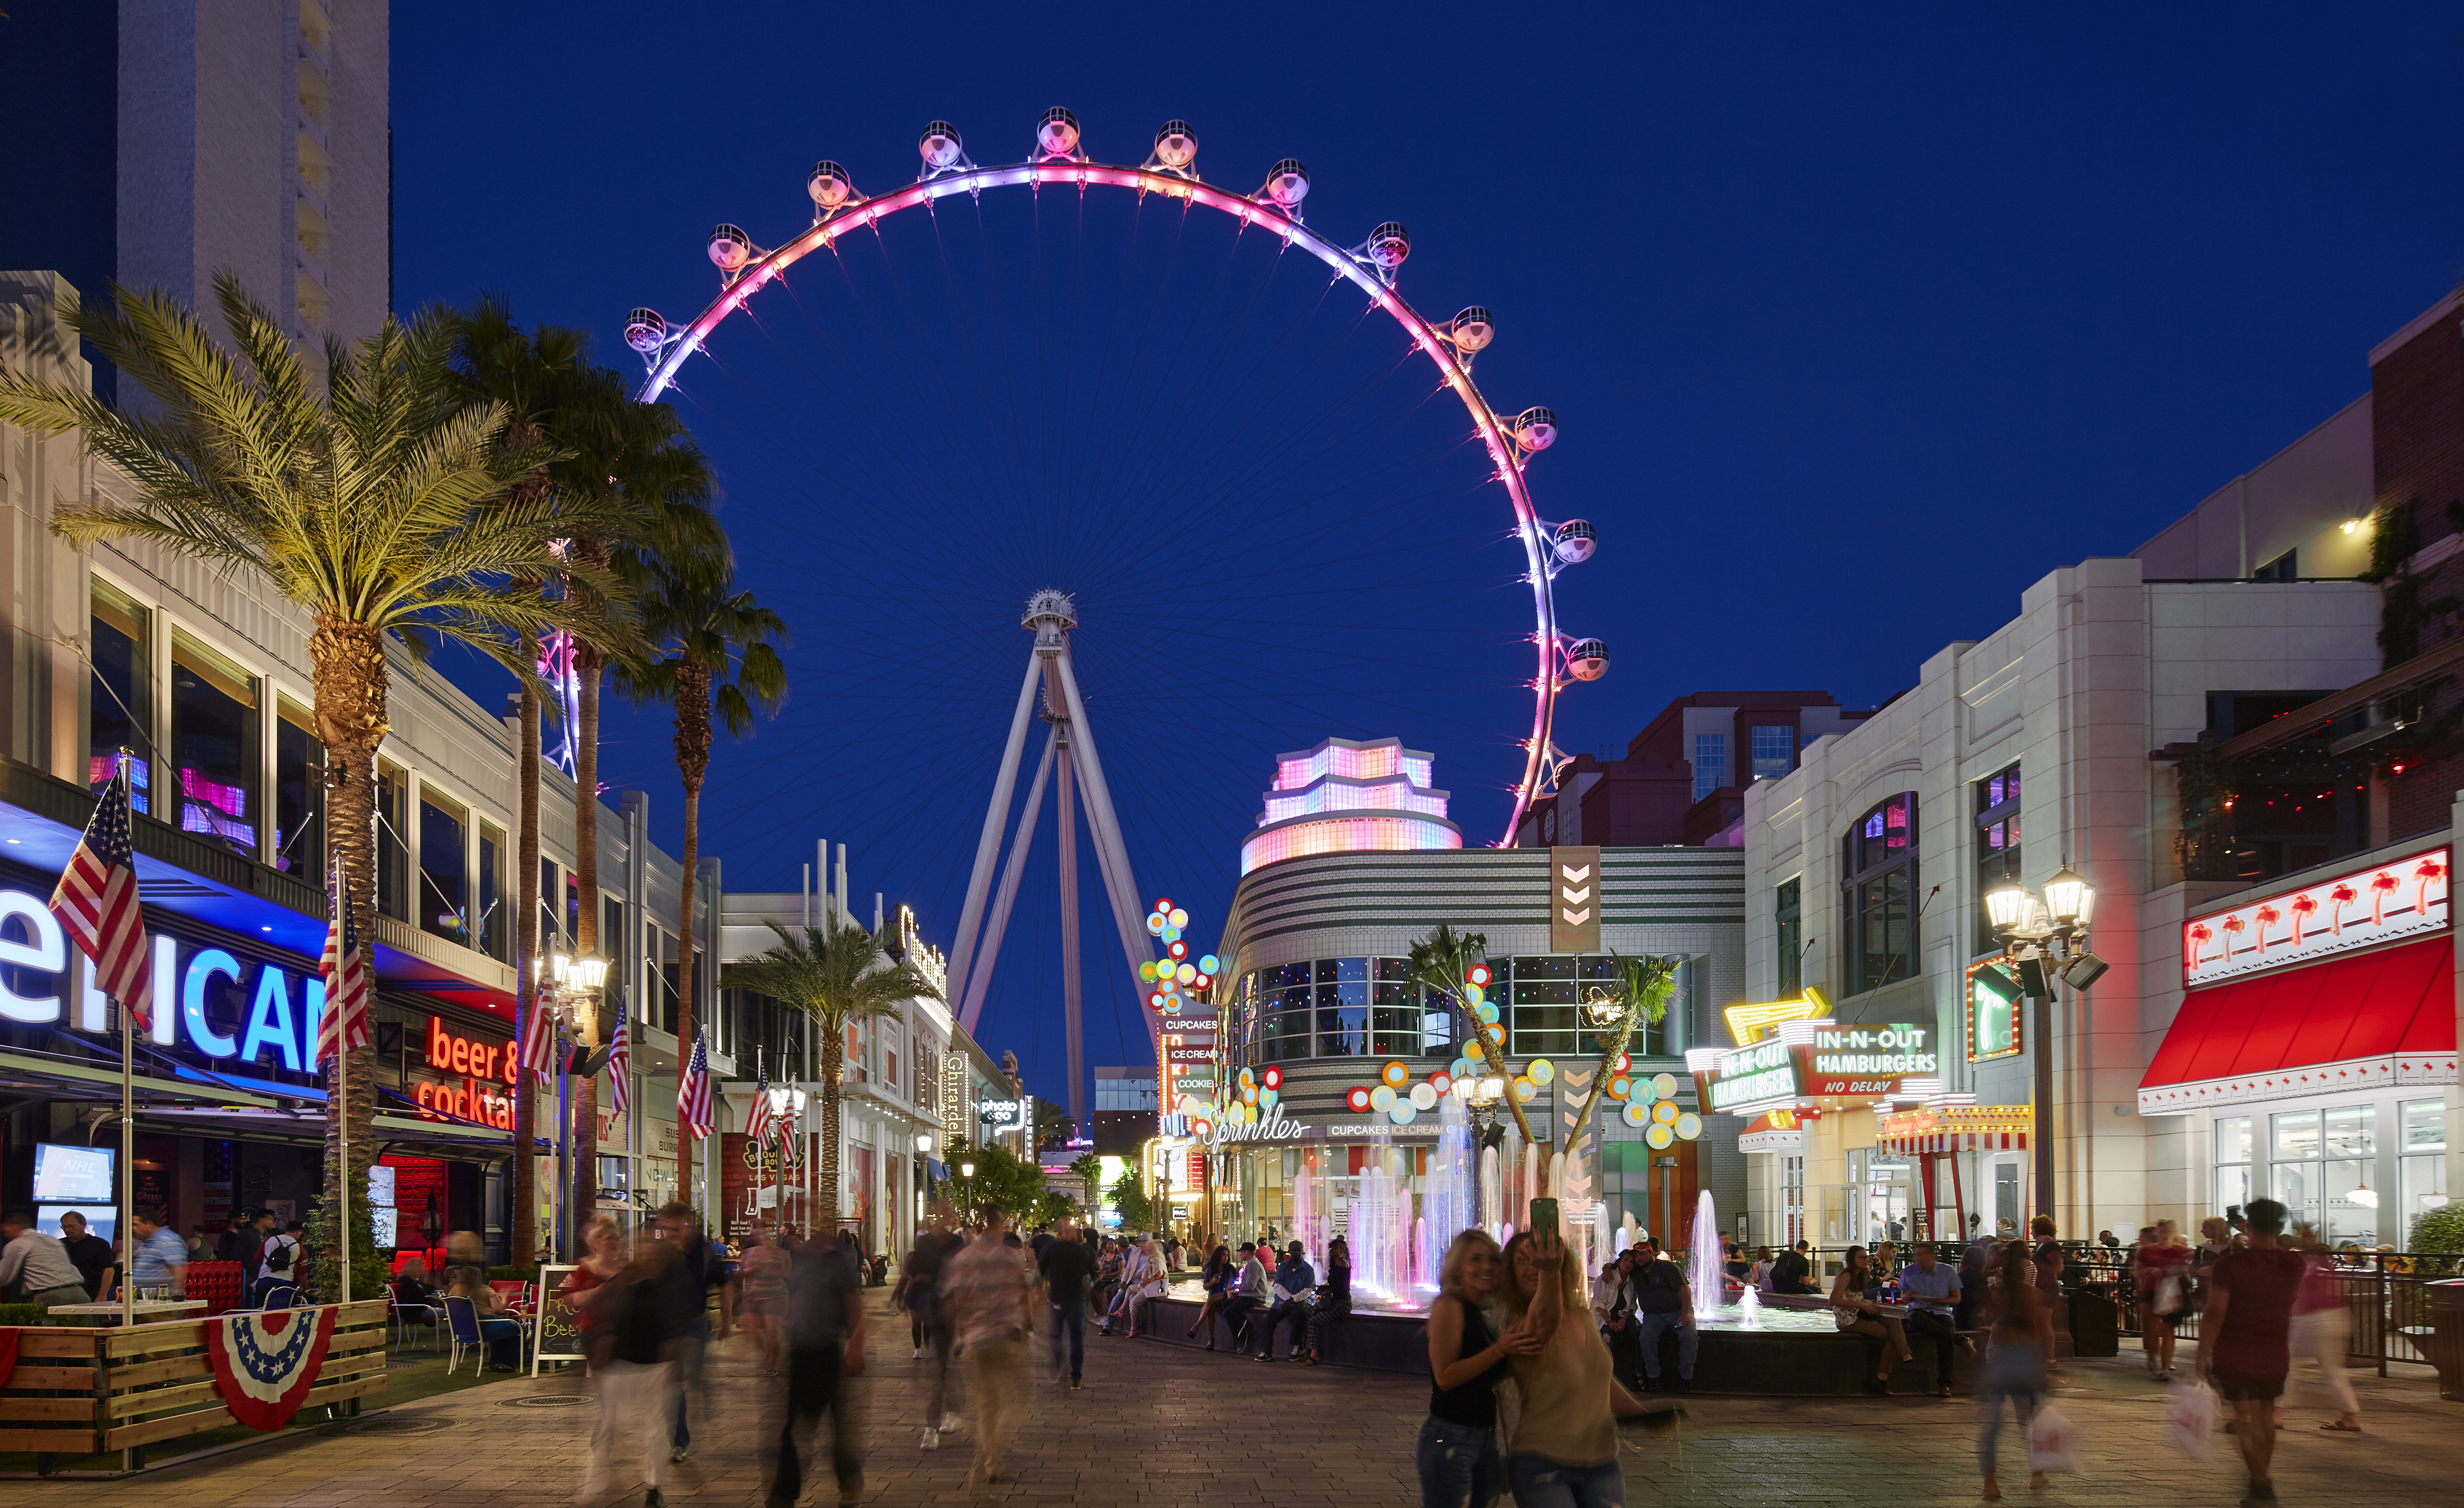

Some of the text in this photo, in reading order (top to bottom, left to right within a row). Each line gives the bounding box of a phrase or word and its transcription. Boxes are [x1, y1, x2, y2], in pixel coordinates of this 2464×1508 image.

[1166, 1020, 1218, 1030] CUPCAKES
[1817, 1030, 1926, 1049] IN-N-OUT
[431, 1016, 498, 1079] beer
[1171, 1050, 1185, 1059] ICE
[1816, 1054, 1937, 1073] HAMBURGERS
[1825, 1081, 1892, 1093] NO DELAY
[417, 1077, 524, 1131] cocktai
[947, 1056, 964, 1147] Ghirardel
[981, 1099, 1018, 1114] photo
[665, 1127, 679, 1139] SUS
[1202, 1102, 1313, 1155] Sprinkles
[1332, 1125, 1388, 1135] CUPCAKES
[1392, 1125, 1407, 1134] ICE
[1408, 1125, 1443, 1134] CREAM
[659, 1141, 678, 1153] BURR
[63, 1158, 96, 1173] NHL
